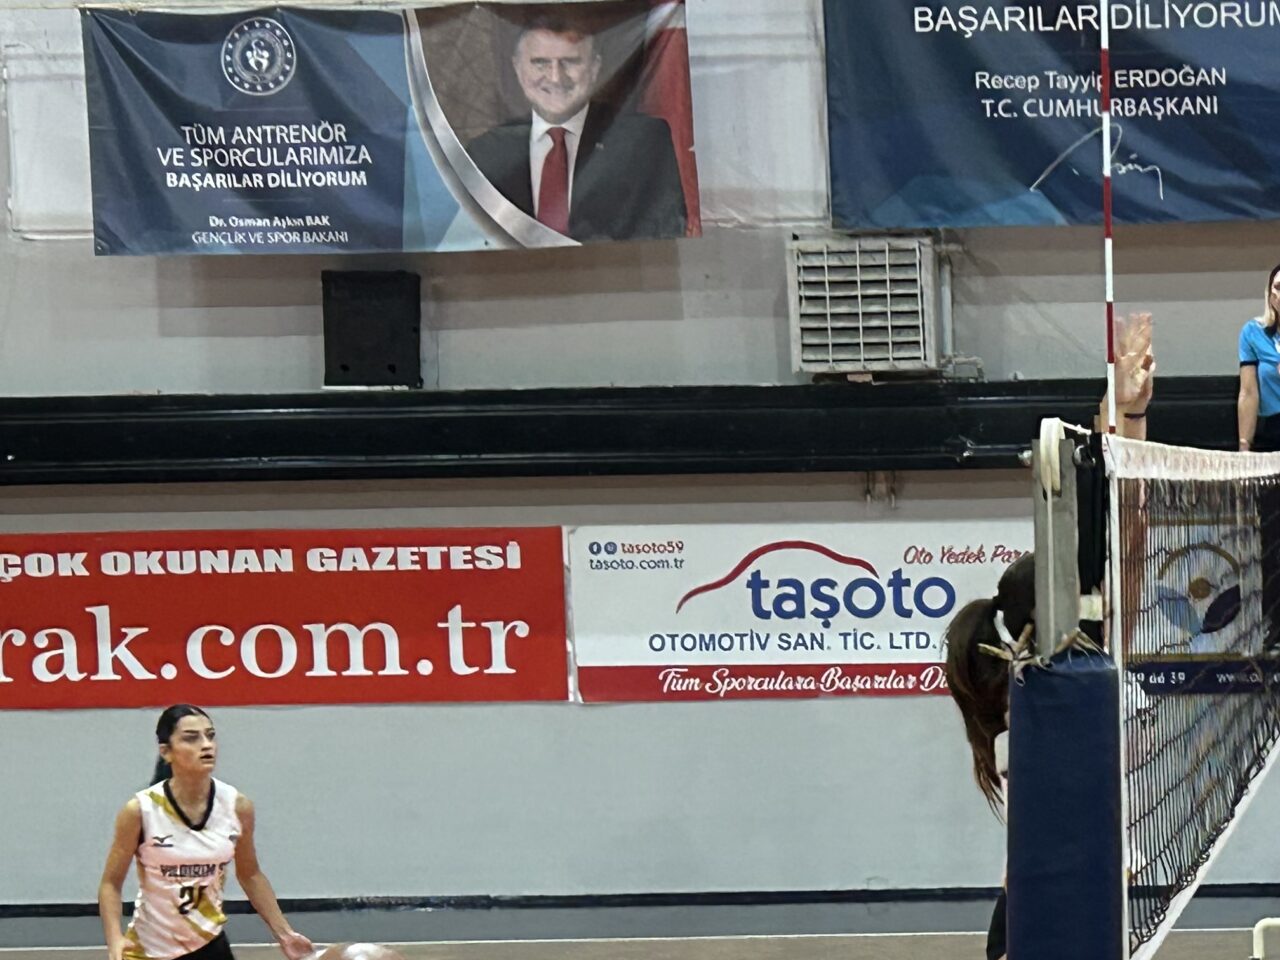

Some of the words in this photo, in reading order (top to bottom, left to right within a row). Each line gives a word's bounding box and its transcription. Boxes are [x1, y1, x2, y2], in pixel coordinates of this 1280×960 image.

[913, 3, 1100, 37] BAŞARILAR
[974, 71, 1040, 93] Recep
[1114, 63, 1228, 89] ERDOĞAN
[981, 99, 1018, 119] T.C.
[180, 123, 226, 145] TÜM
[231, 120, 347, 145] ANTRENÖR
[157, 148, 185, 167] VE
[190, 145, 372, 168] SPORCULARIMIZA
[166, 171, 264, 191] BAŞARILAR
[267, 168, 367, 189] DİLİYORUM
[0, 551, 90, 583] ÇOK
[100, 548, 294, 576] OKUNAN
[306, 541, 522, 573] GAZETESİ
[746, 568, 957, 628] taşoto
[649, 628, 771, 652] OTOMOTİV
[777, 632, 832, 651] SAN.
[839, 627, 881, 651] TİC.
[888, 631, 938, 650] LTD.
